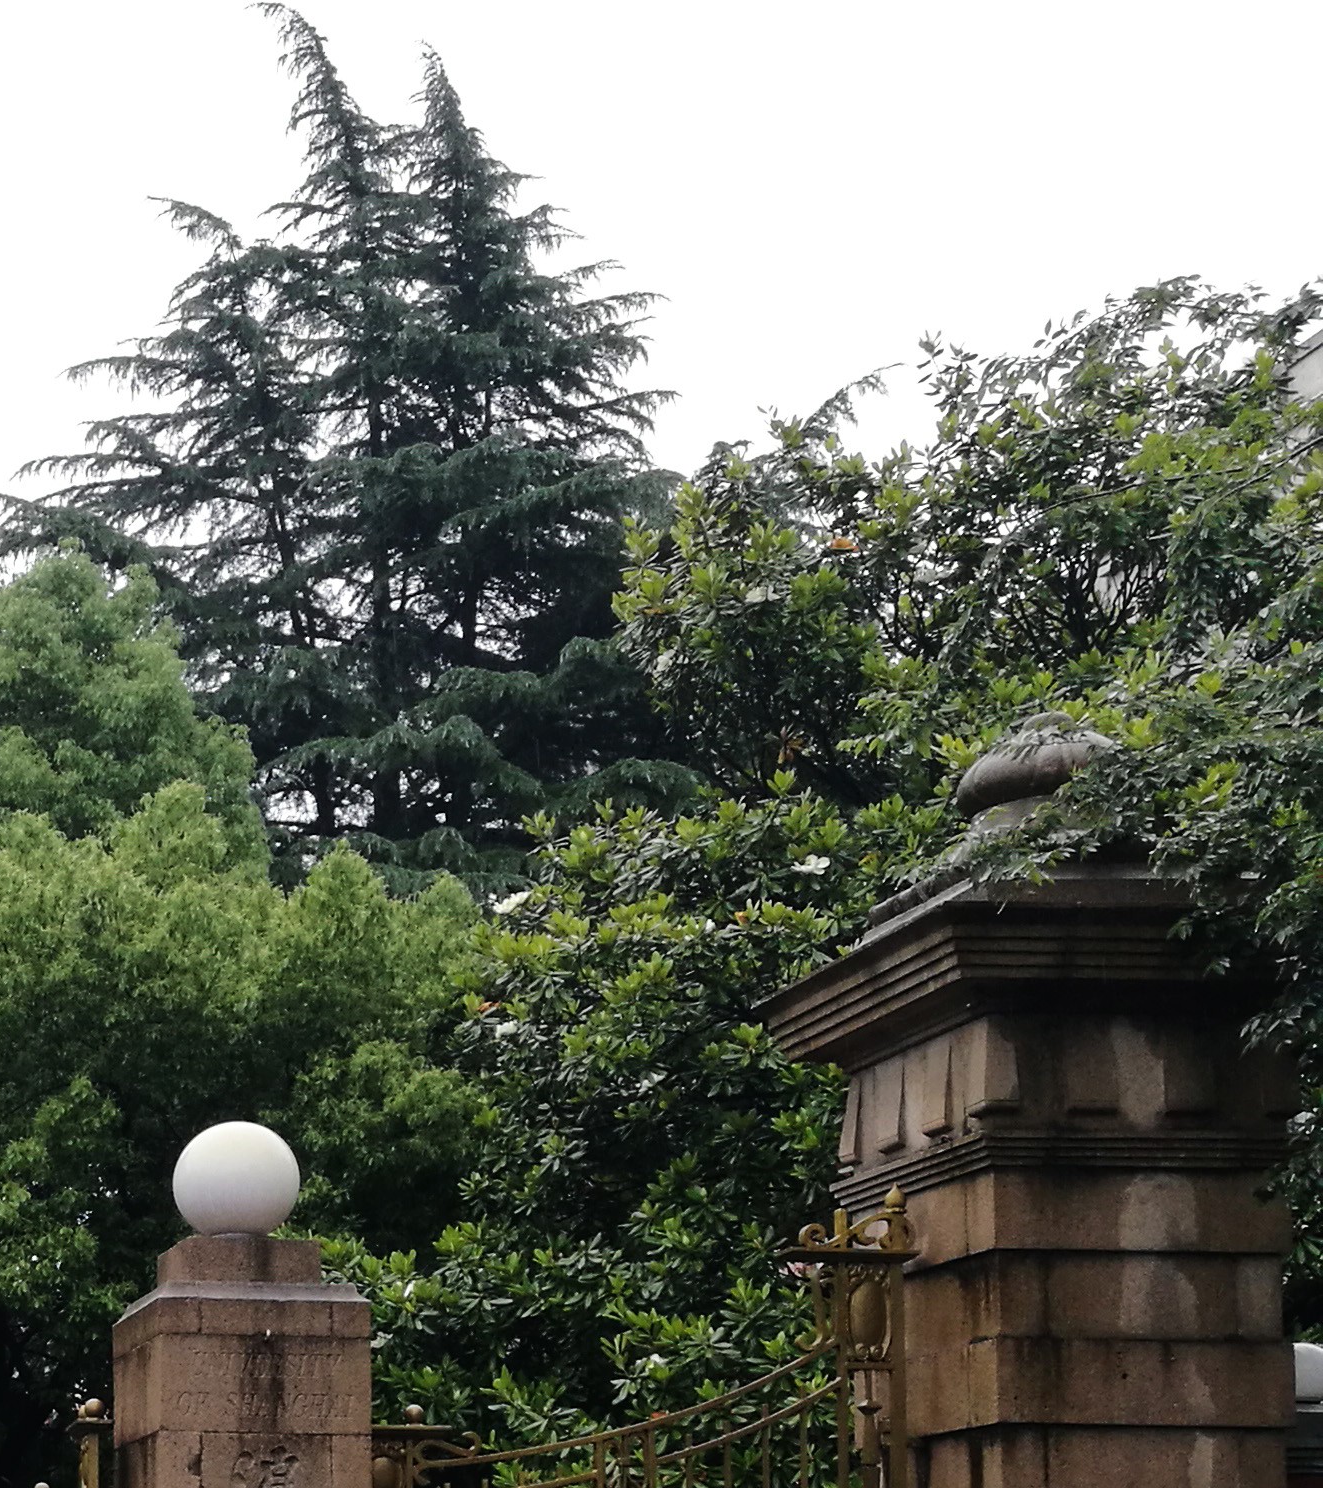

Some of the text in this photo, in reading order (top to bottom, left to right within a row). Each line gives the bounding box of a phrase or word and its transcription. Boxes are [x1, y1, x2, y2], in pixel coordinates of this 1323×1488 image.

[191, 1350, 343, 1379] UNIVERSITY
[177, 1391, 357, 1419] OF SHANGHAI
